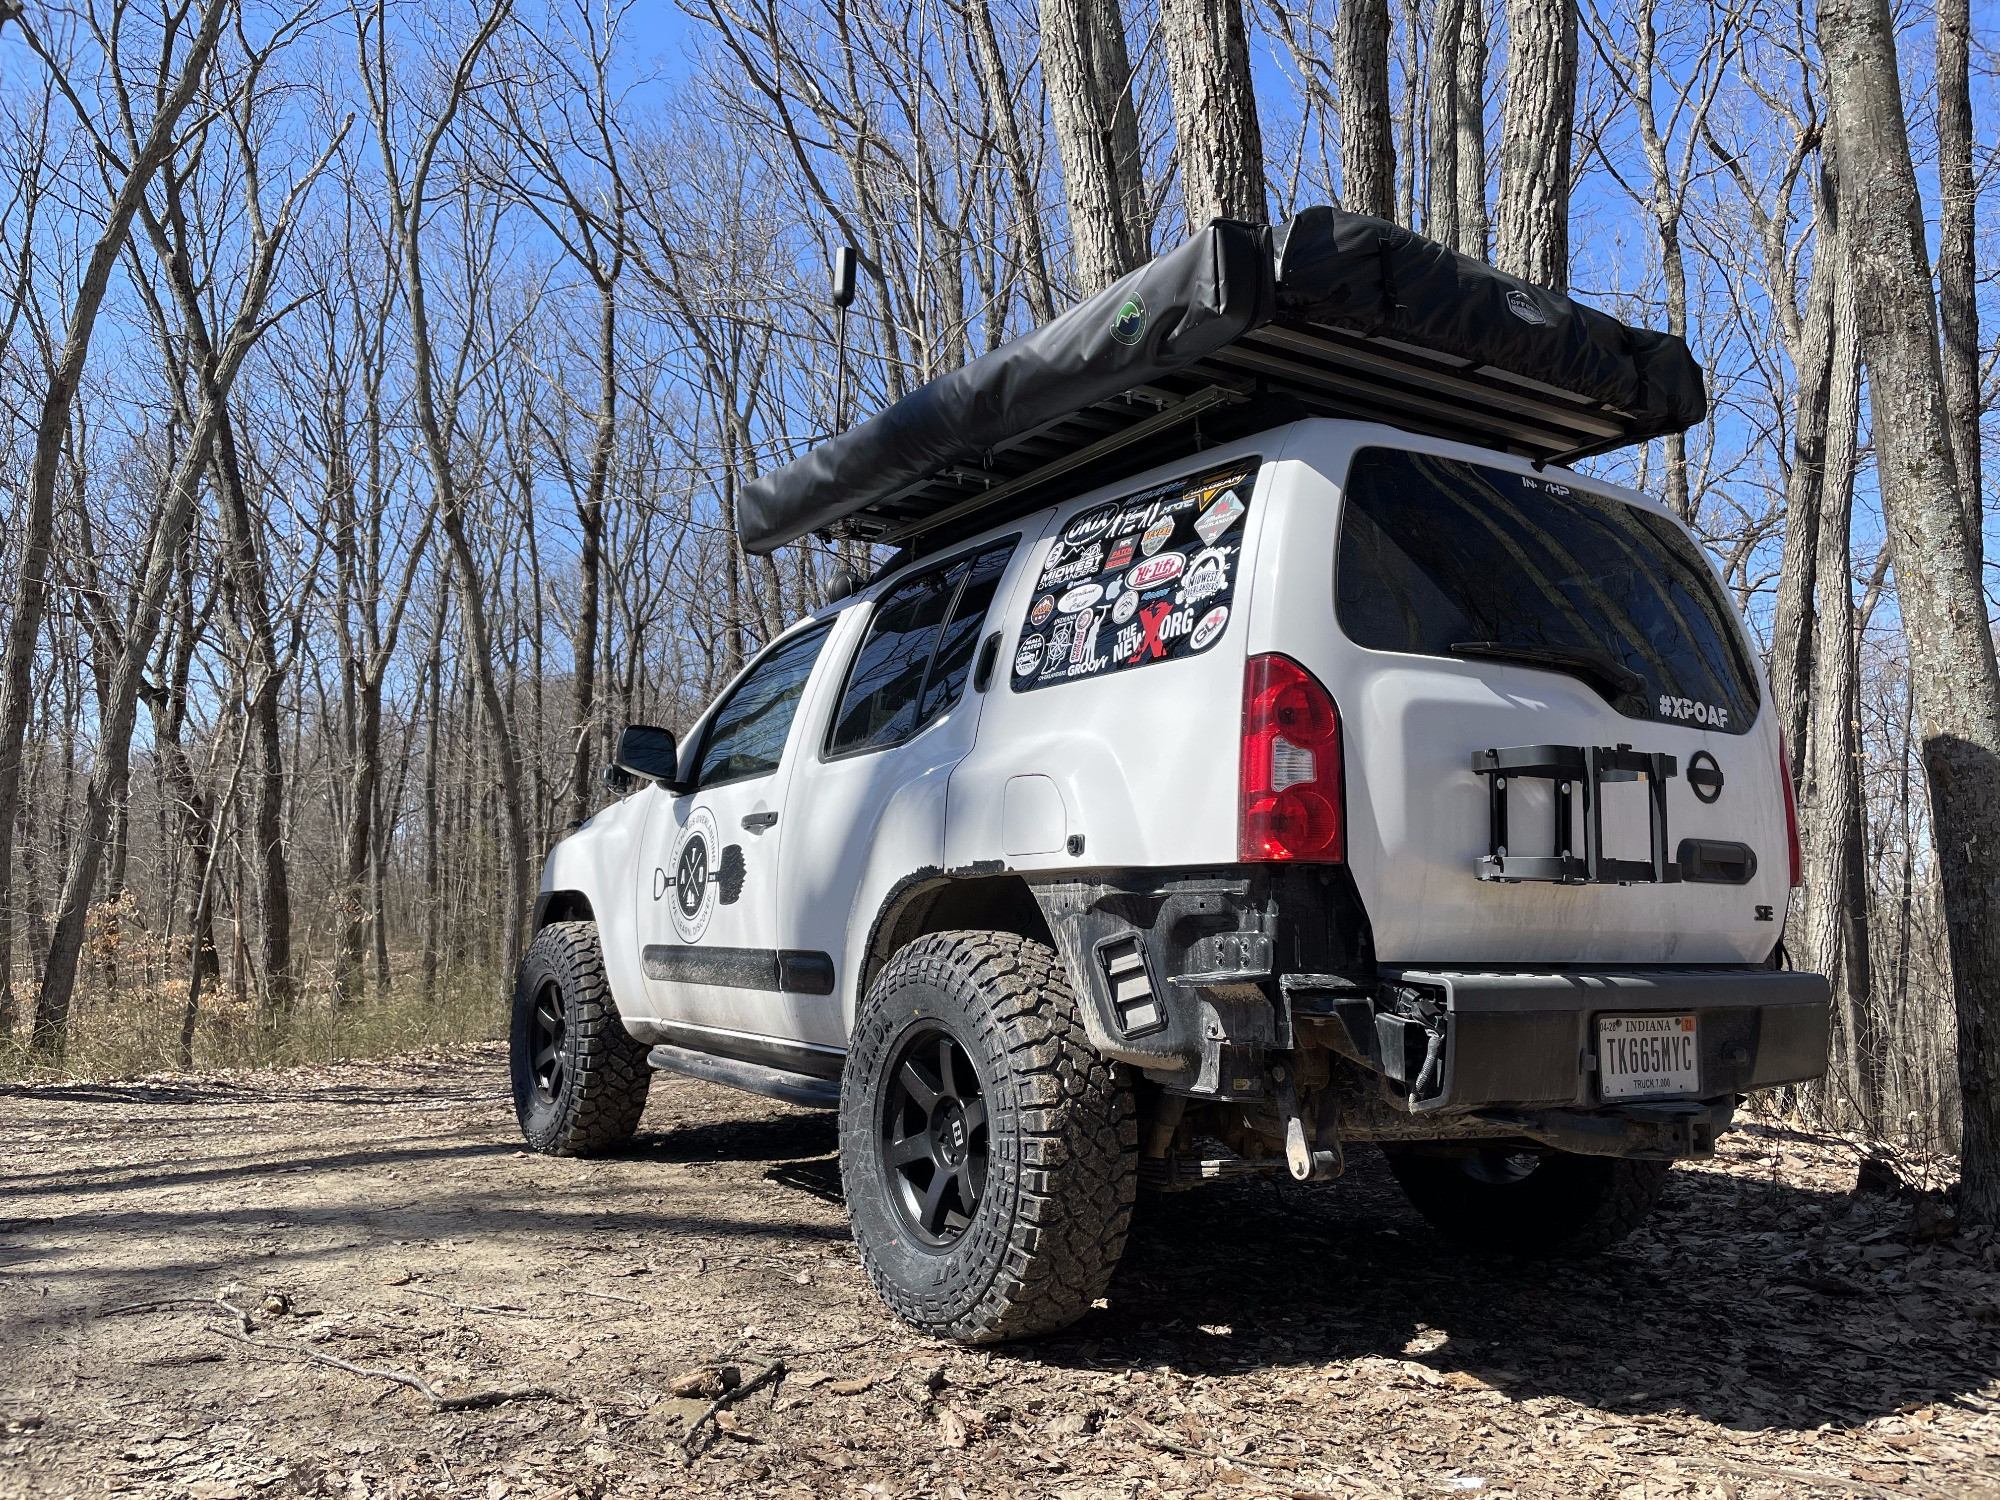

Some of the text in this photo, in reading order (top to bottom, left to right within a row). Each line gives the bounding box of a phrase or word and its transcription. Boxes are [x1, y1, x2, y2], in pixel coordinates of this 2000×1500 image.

[1038, 564, 1100, 590] OVERLANDERS
[1040, 553, 1104, 584] MIDWEST
[1190, 570, 1220, 587] MIDWEST
[1112, 630, 1146, 663] NEW
[1158, 607, 1195, 641] ORG
[1116, 622, 1138, 644] THE
[1022, 642, 1042, 651] RATED
[1068, 655, 1109, 677] GROOVY
[1754, 905, 1773, 921] SE
[1625, 1019, 1671, 1033] INDIANA
[1606, 1035, 1692, 1075] TK665MYC
[1633, 1078, 1655, 1090] TRUCK
